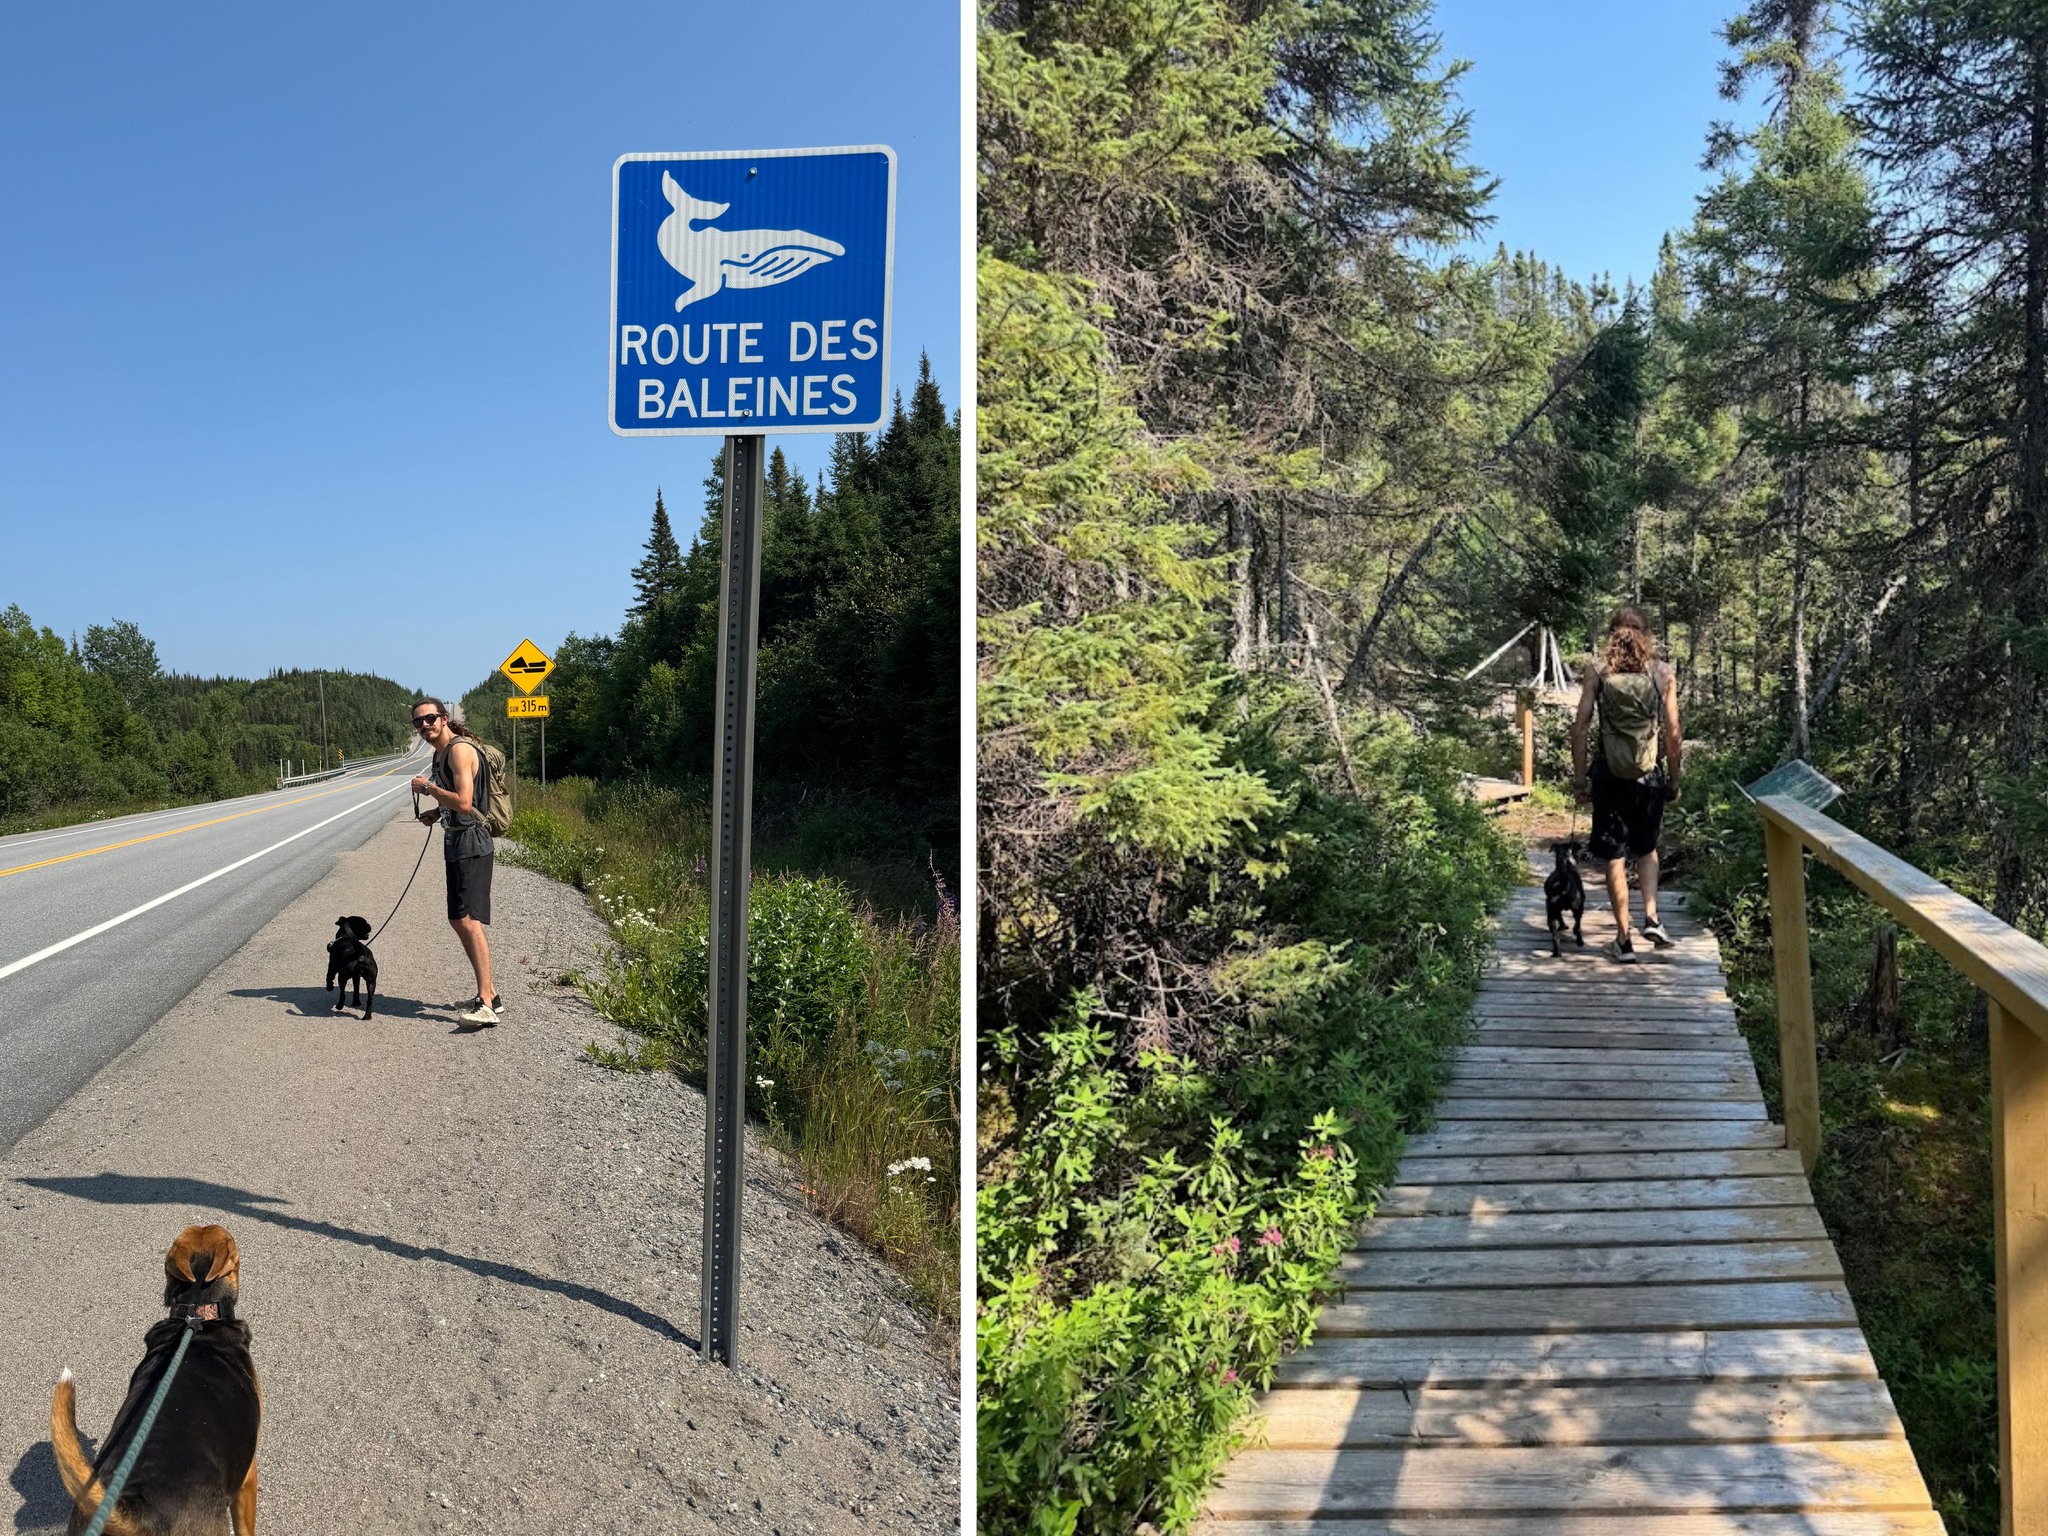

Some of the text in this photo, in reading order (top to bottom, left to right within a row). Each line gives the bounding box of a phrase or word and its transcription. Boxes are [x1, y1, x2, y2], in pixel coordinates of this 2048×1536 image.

[621, 318, 878, 365] ROUTE DES
[638, 374, 857, 418] BALEINES
[521, 700, 537, 712] 315
